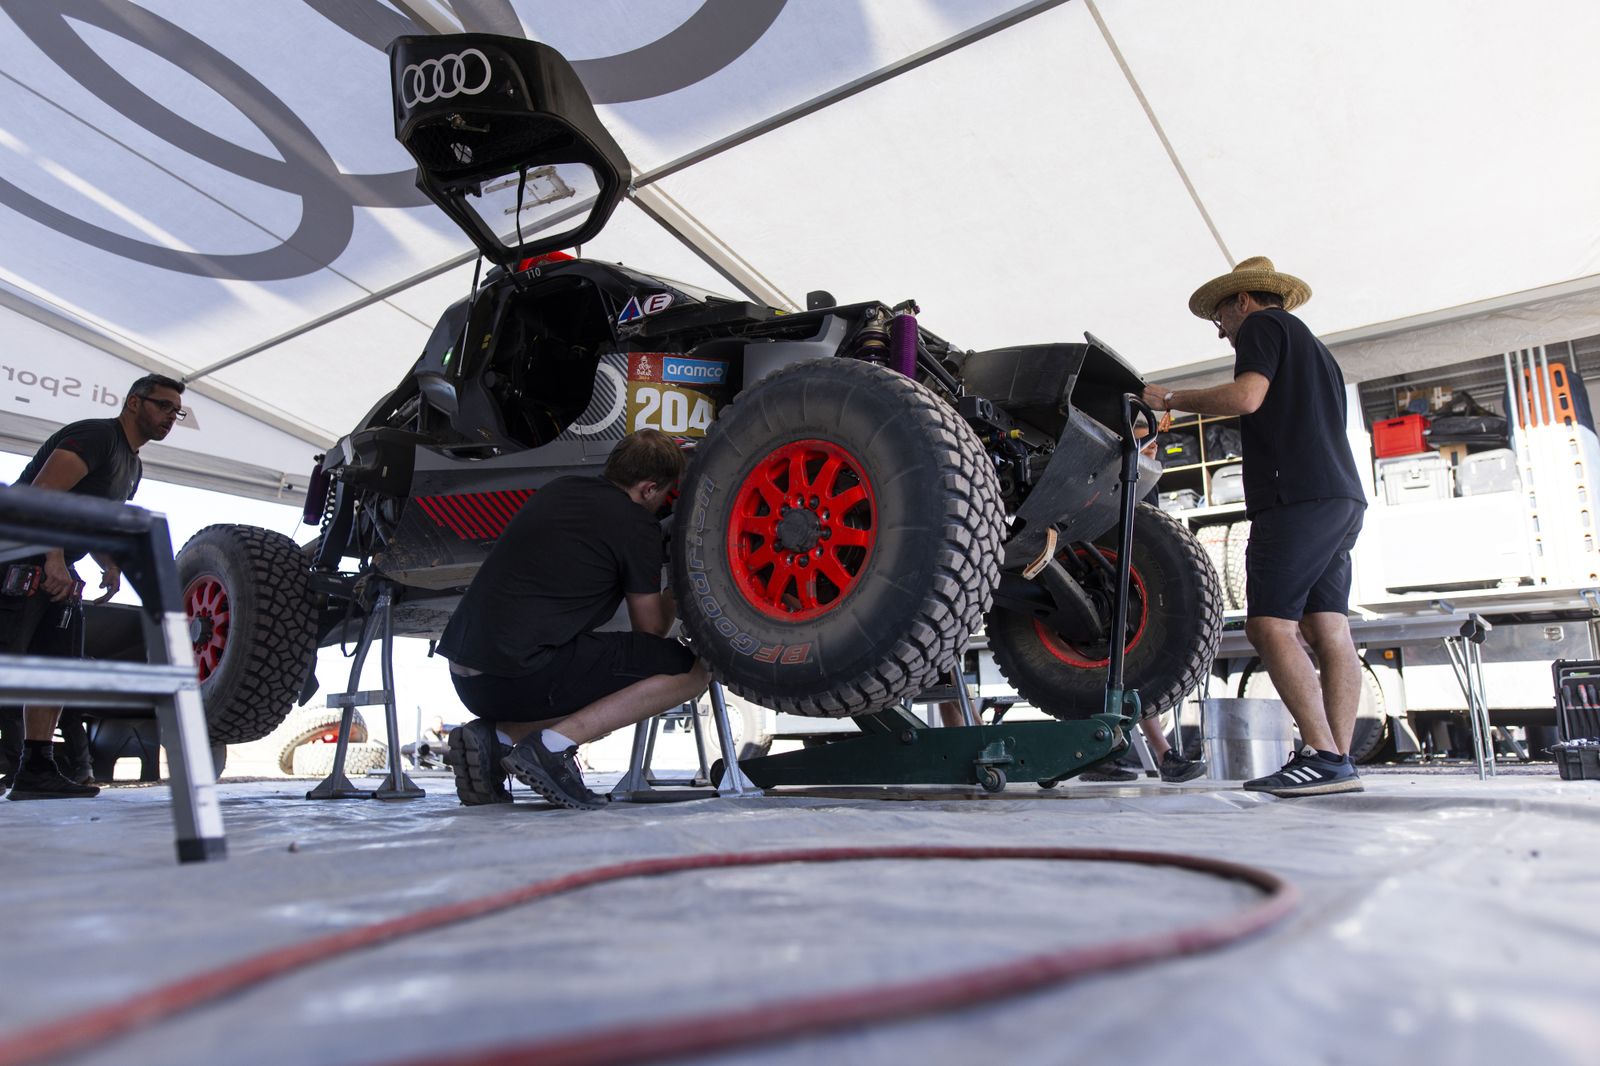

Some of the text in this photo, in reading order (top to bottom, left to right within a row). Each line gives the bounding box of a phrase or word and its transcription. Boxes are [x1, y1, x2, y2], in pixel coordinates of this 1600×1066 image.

[526, 267, 541, 280] 110
[648, 295, 667, 312] E
[667, 364, 723, 377] aramco
[634, 387, 713, 435] 204
